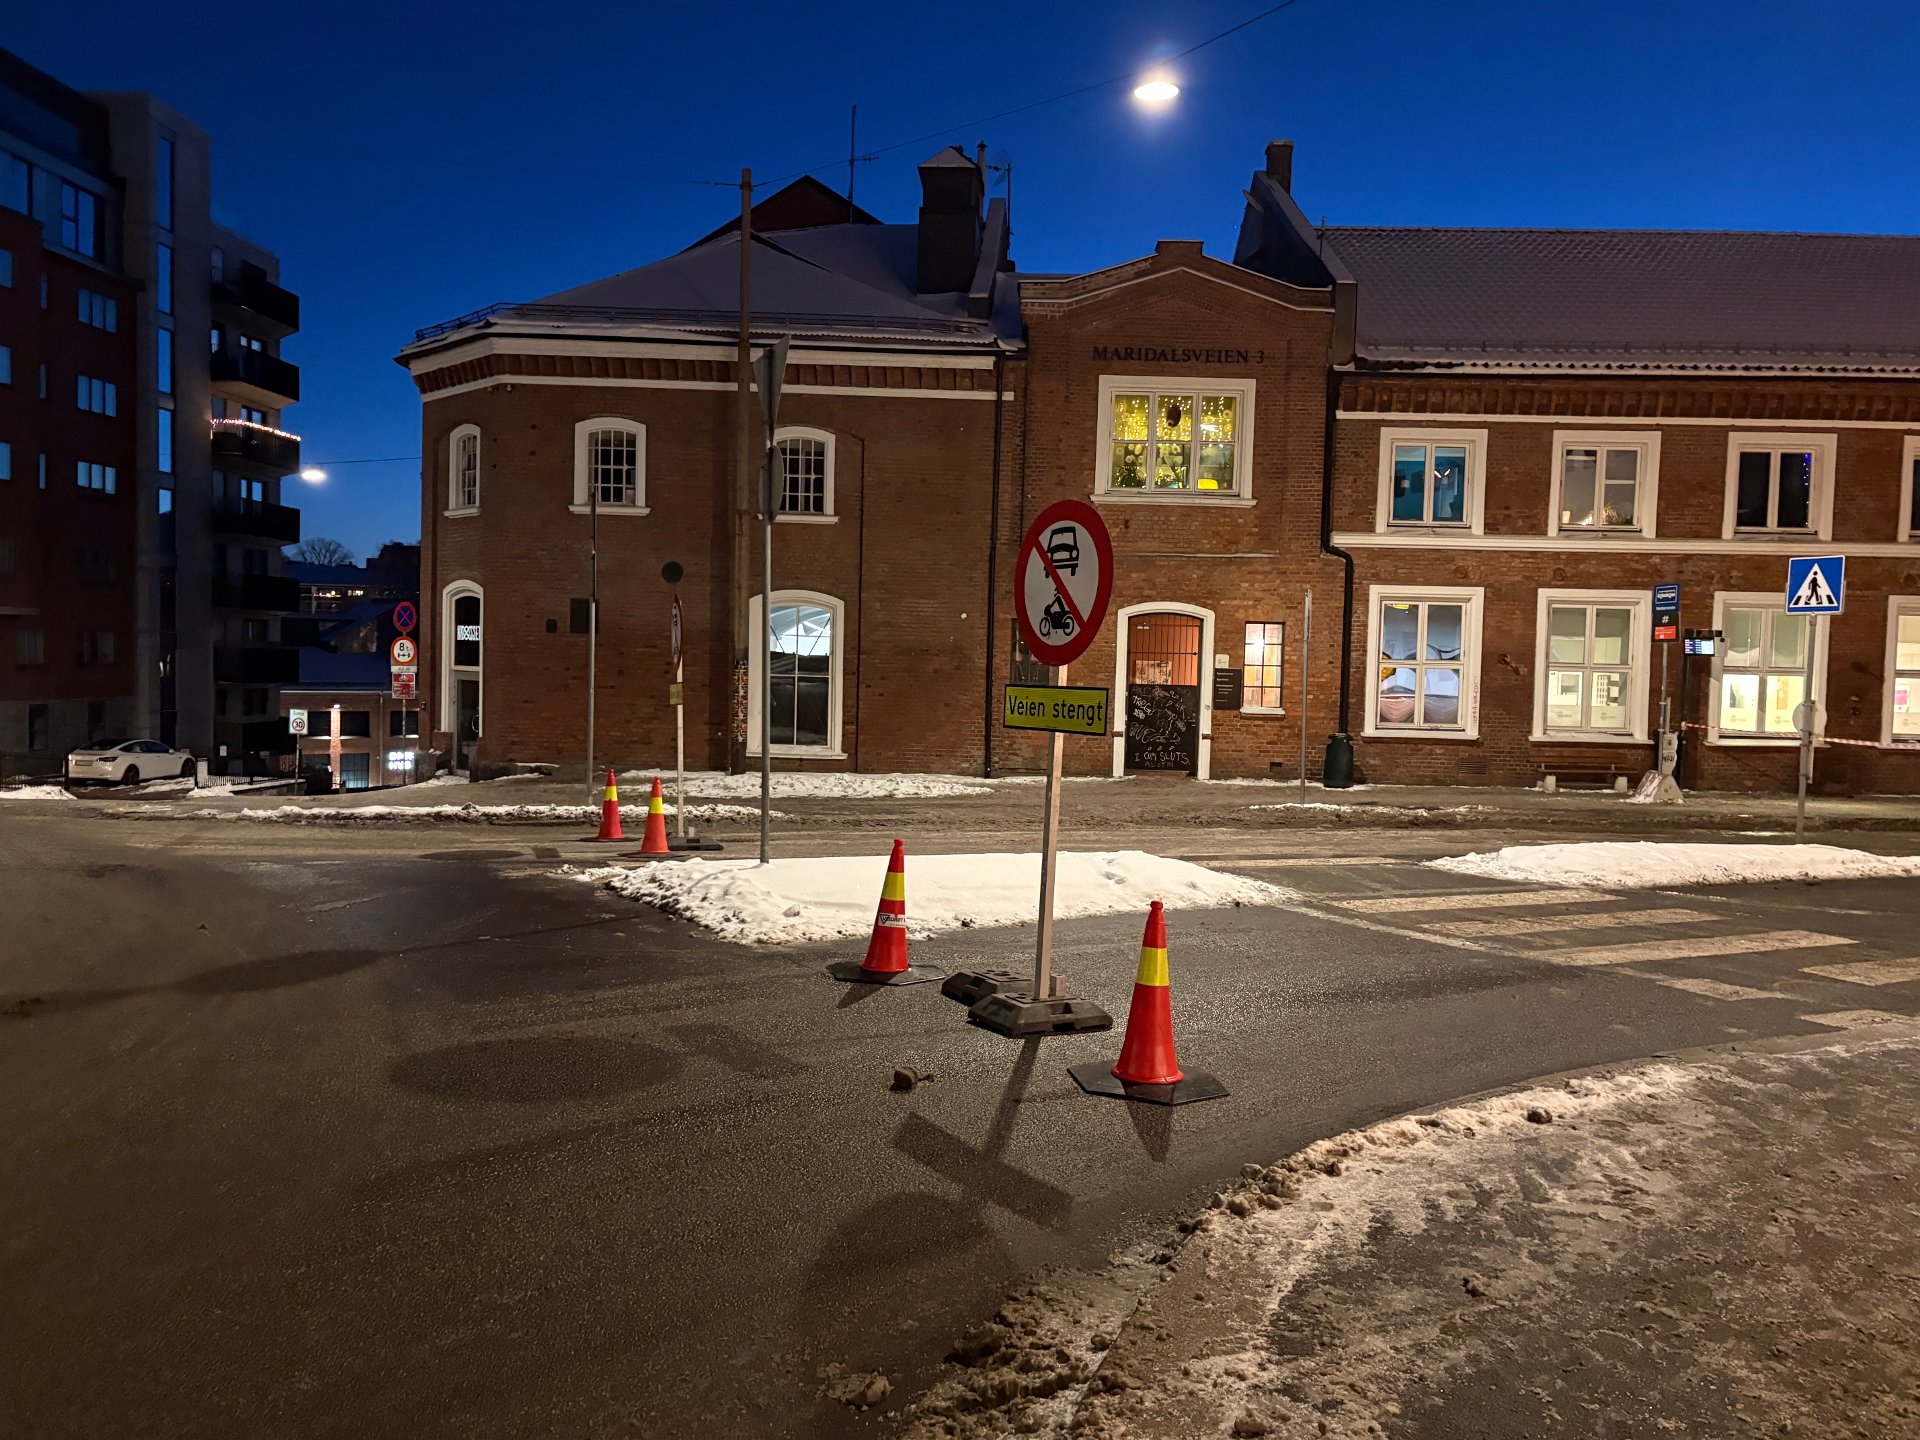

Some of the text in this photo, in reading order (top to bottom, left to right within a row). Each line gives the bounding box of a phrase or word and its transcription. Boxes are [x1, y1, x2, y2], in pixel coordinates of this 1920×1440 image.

[1092, 346, 1265, 364] MARIDALSVEIEN 3
[399, 642, 405, 651] 8
[1008, 695, 1103, 727] Veien stengt
[294, 721, 304, 729] 30
